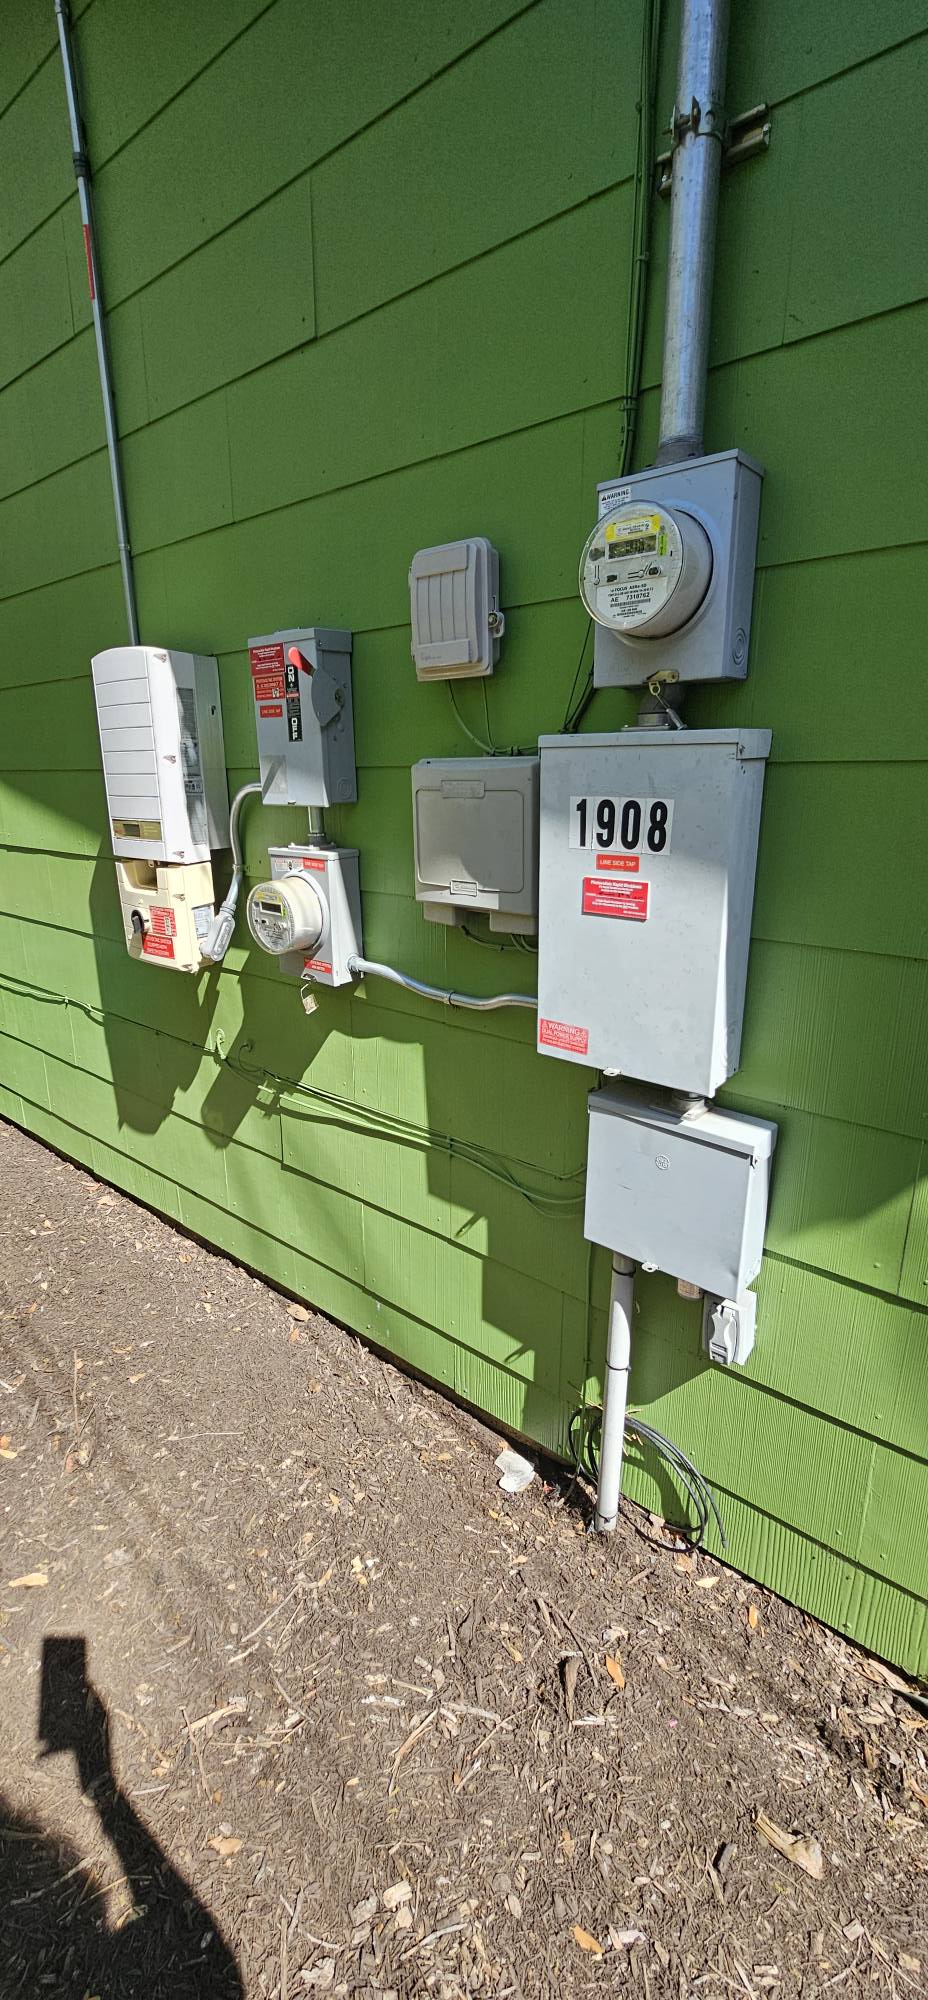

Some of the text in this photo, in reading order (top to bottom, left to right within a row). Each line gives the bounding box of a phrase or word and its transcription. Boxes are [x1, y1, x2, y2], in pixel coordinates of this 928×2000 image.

[287, 666, 295, 682] ON
[576, 798, 668, 853] 1908
[548, 1022, 580, 1036] WARNING
